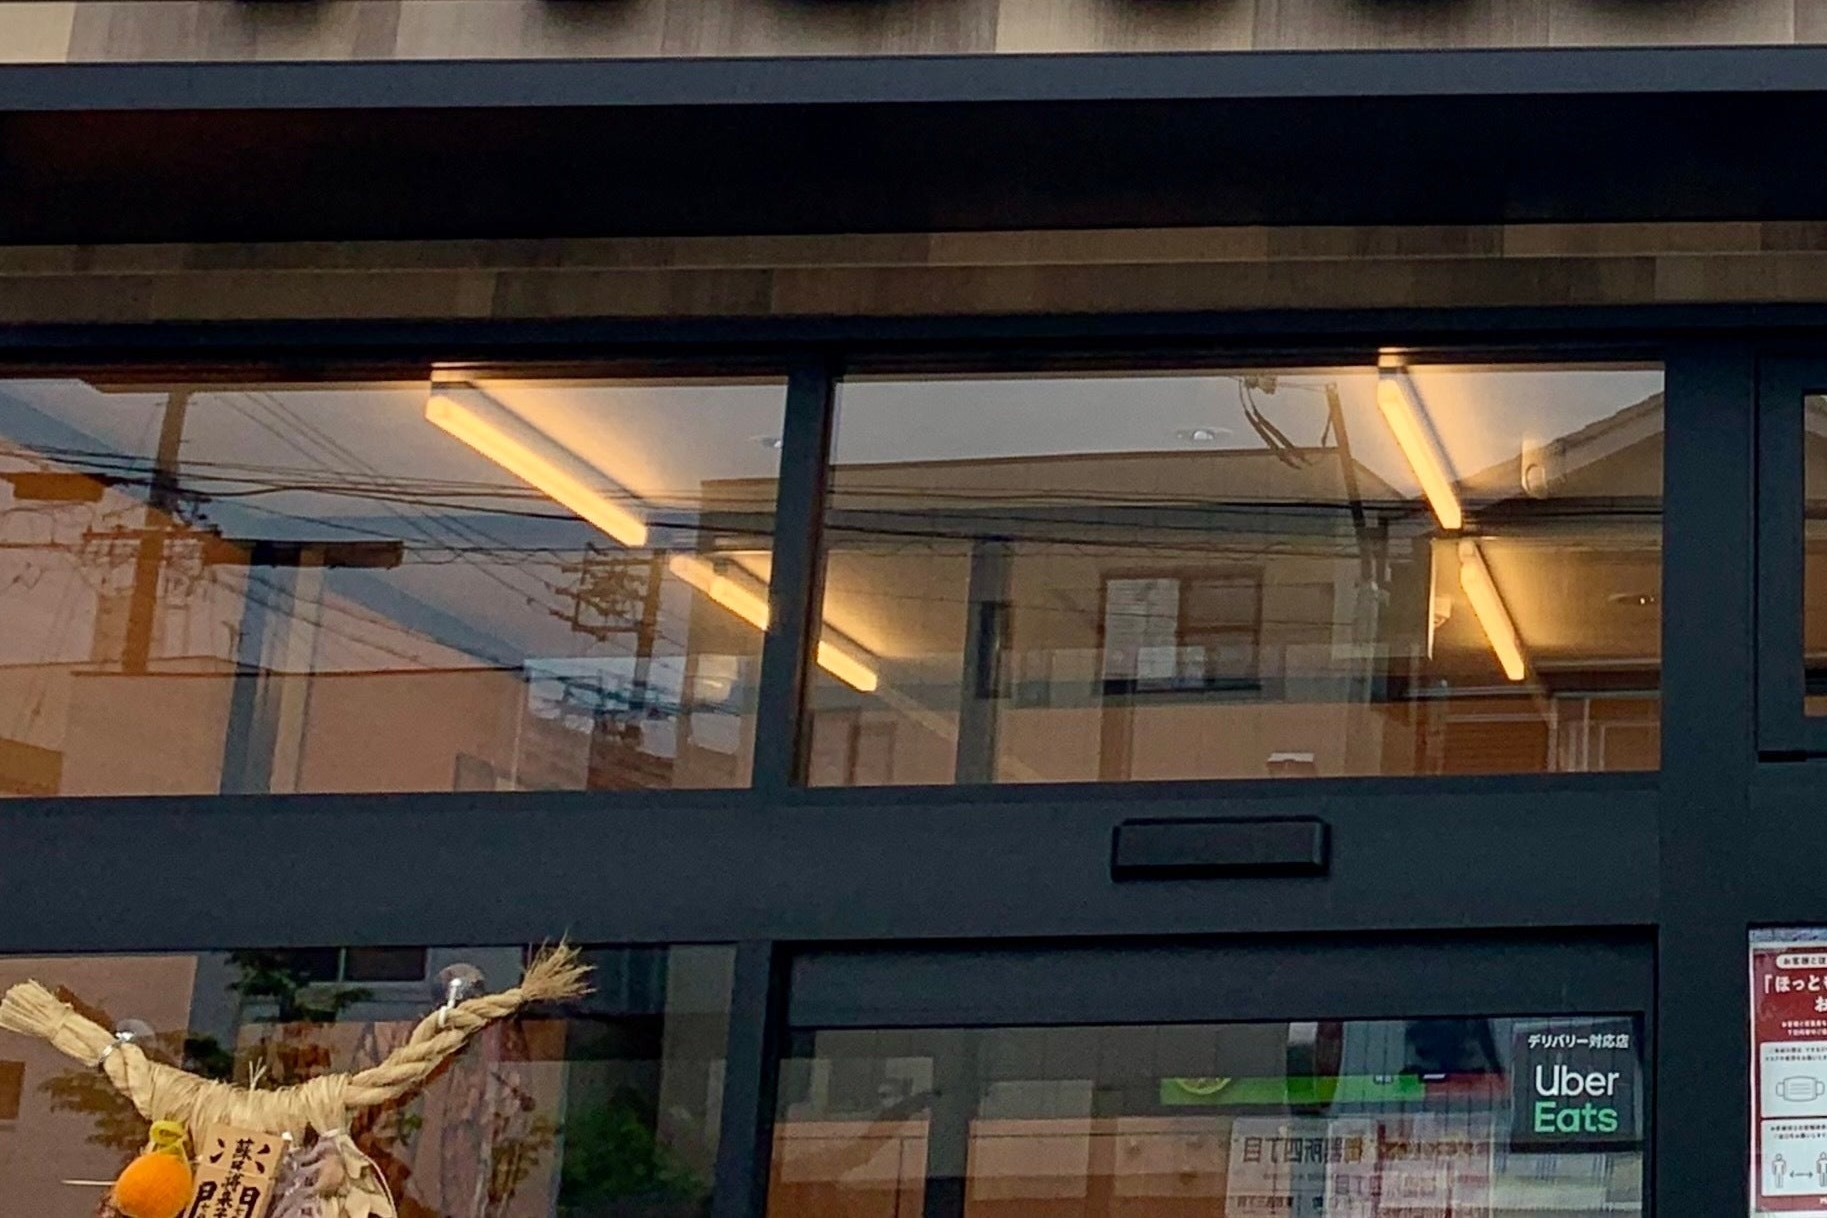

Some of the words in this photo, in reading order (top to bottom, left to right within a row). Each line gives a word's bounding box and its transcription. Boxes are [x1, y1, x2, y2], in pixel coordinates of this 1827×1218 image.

[1528, 1033, 1630, 1049] デリバリー対応店
[1535, 1065, 1620, 1096] Uber
[1534, 1101, 1618, 1133] Eats
